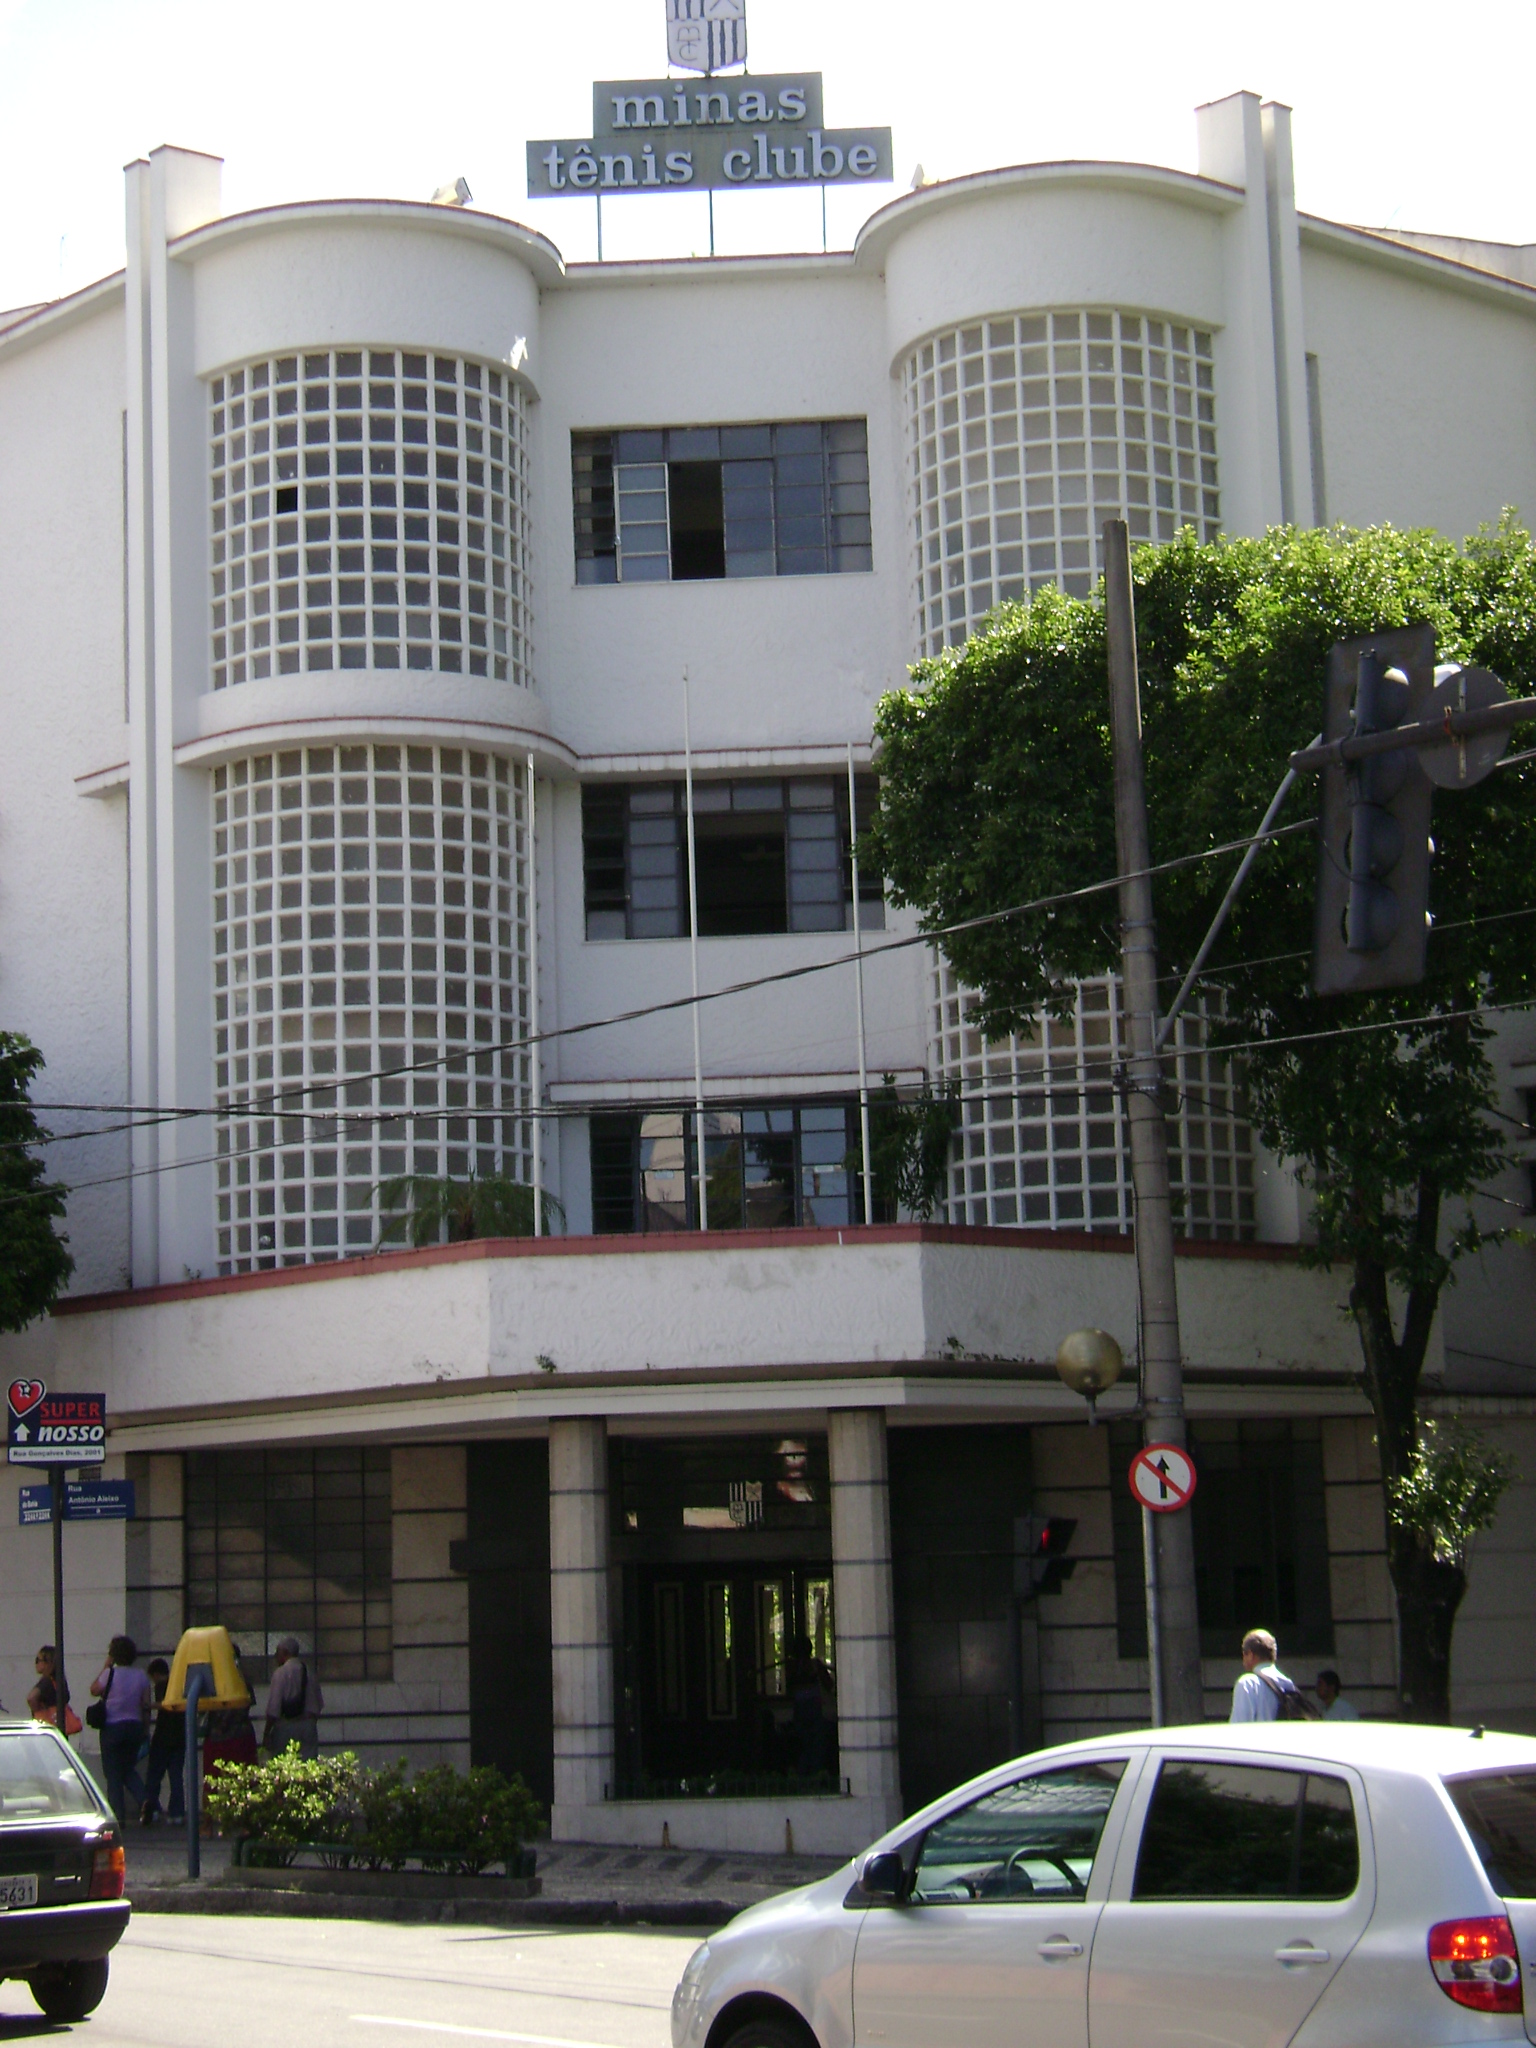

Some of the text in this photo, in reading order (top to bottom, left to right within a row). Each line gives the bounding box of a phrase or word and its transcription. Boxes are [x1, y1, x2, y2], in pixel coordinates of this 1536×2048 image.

[611, 84, 807, 129] minas
[544, 132, 878, 189] tênis clube
[40, 1402, 100, 1418] SUPER
[38, 1426, 104, 1442] nosso
[0, 1886, 33, 1903] 5631
